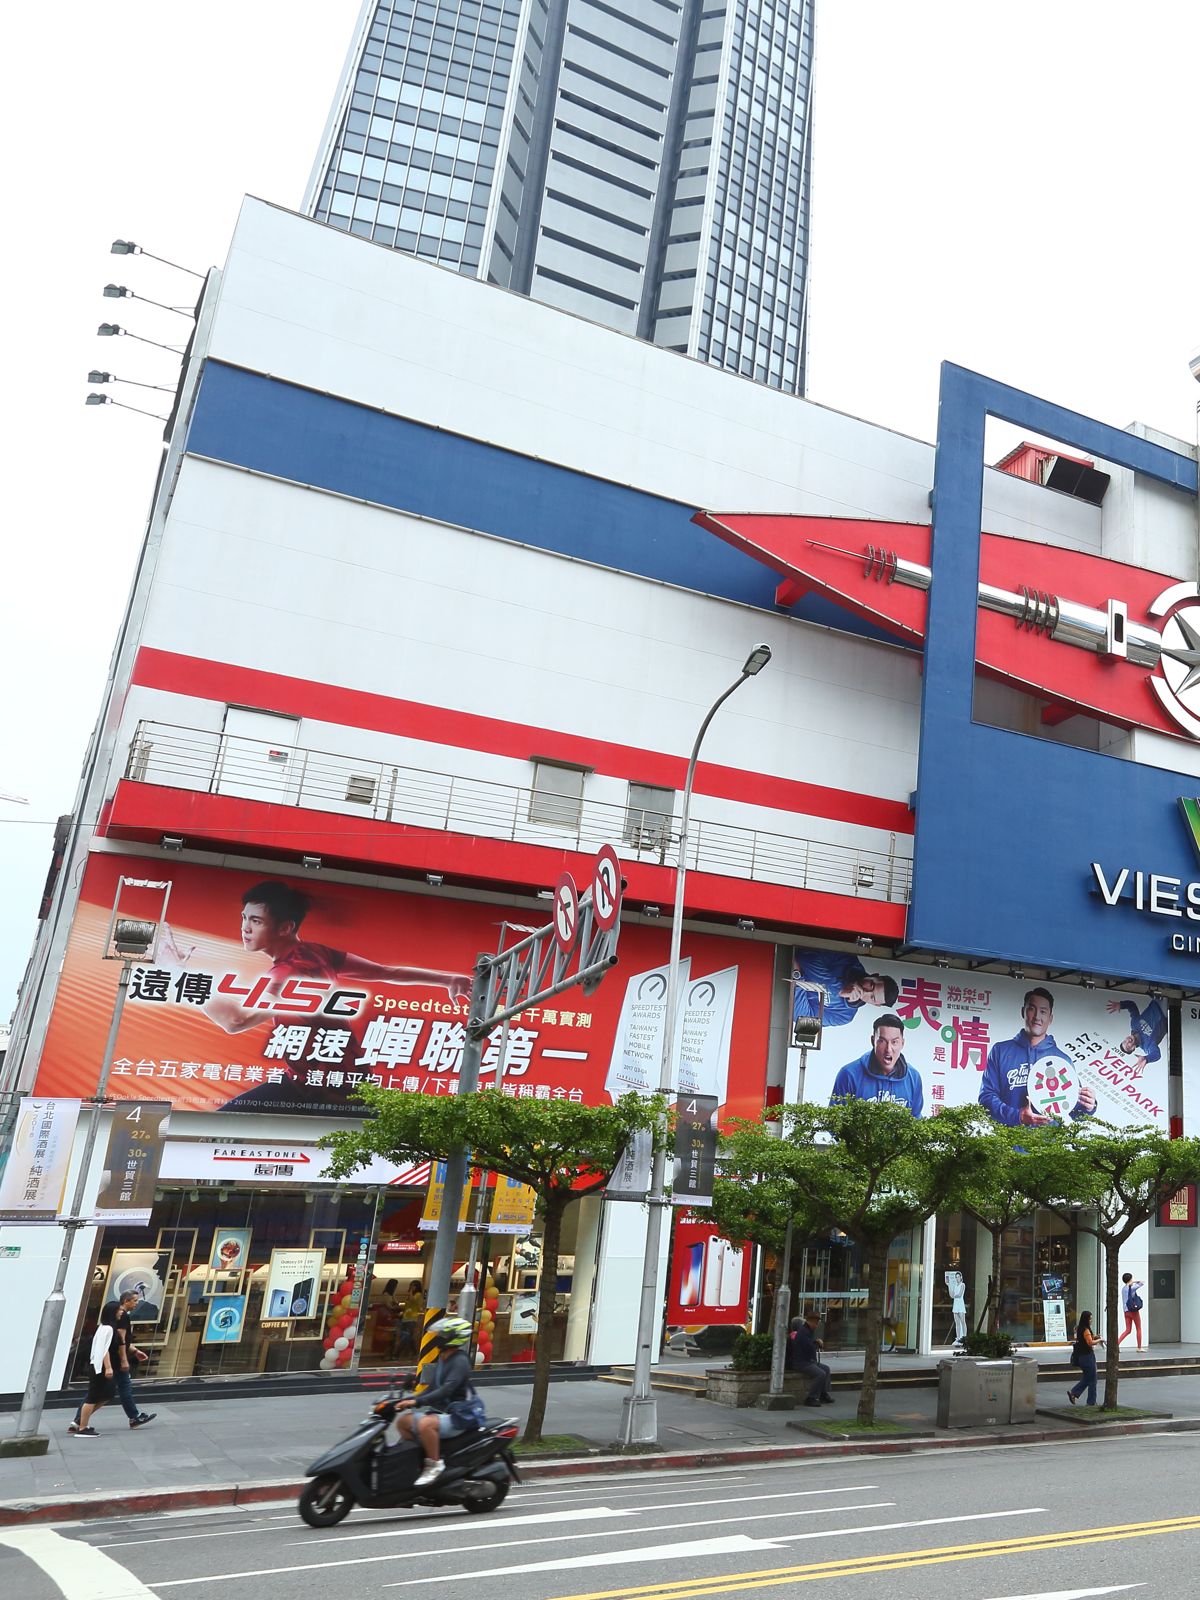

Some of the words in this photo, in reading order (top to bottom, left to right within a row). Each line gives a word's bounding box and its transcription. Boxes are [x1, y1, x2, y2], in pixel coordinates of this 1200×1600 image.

[128, 967, 214, 1006] 遠傳
[374, 994, 469, 1016] Speedtest
[628, 1042, 651, 1050] MOBILE
[629, 1033, 655, 1041] FASTEST
[1064, 1032, 1091, 1052] 3.17
[623, 1050, 654, 1060] NETWORK
[1103, 1049, 1144, 1081] VERY
[1089, 1059, 1124, 1086] FUN
[1121, 1084, 1165, 1118] PARK
[125, 1106, 142, 1124] 4
[686, 1099, 698, 1115] 4
[261, 1321, 280, 1329] COFFEE
